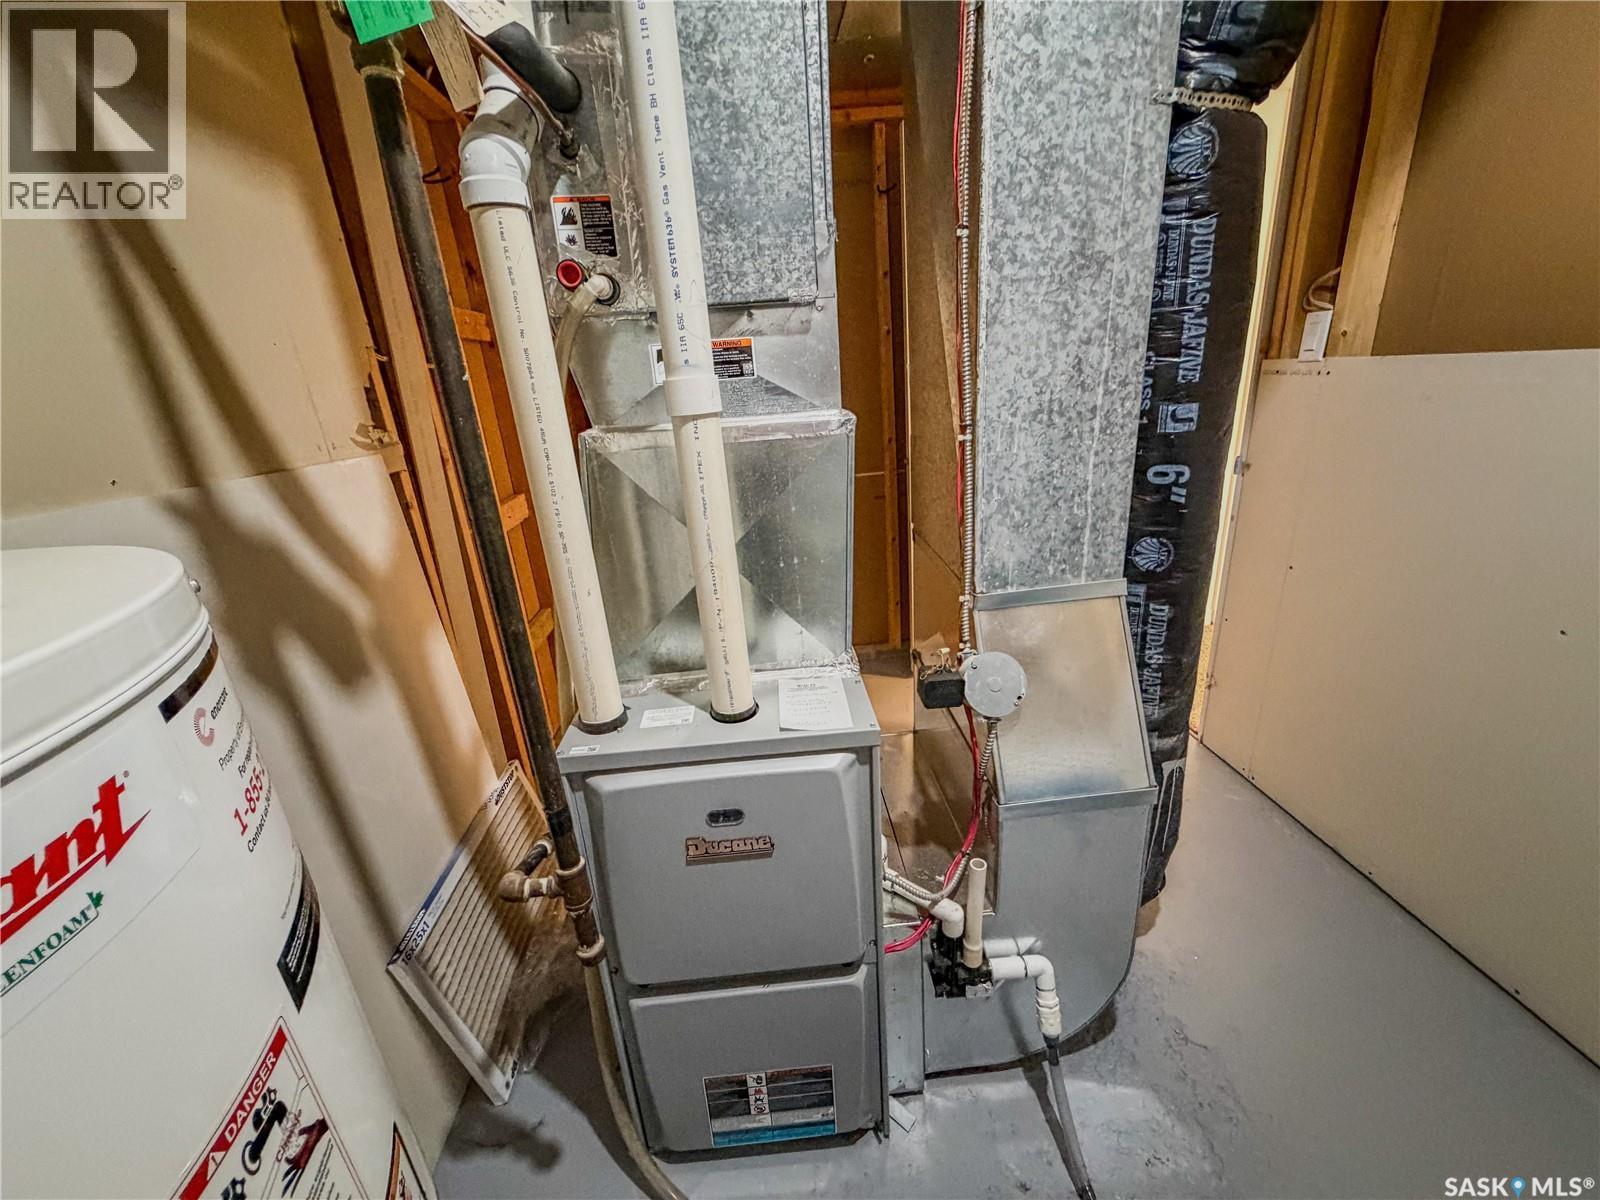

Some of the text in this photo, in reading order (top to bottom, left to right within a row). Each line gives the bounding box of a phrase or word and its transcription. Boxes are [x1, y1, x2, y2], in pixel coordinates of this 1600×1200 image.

[645, 48, 655, 86] Class
[648, 93, 658, 109] BH
[654, 115, 662, 144] Type
[658, 151, 666, 178] Vent
[662, 184, 670, 205] Gas
[512, 290, 524, 324] Control
[532, 396, 543, 424] LISTED
[712, 340, 743, 349] WARNING
[219, 739, 239, 771] Property
[247, 815, 267, 853] Contact
[686, 835, 772, 857] Ducane
[224, 1052, 277, 1143] DANGER
